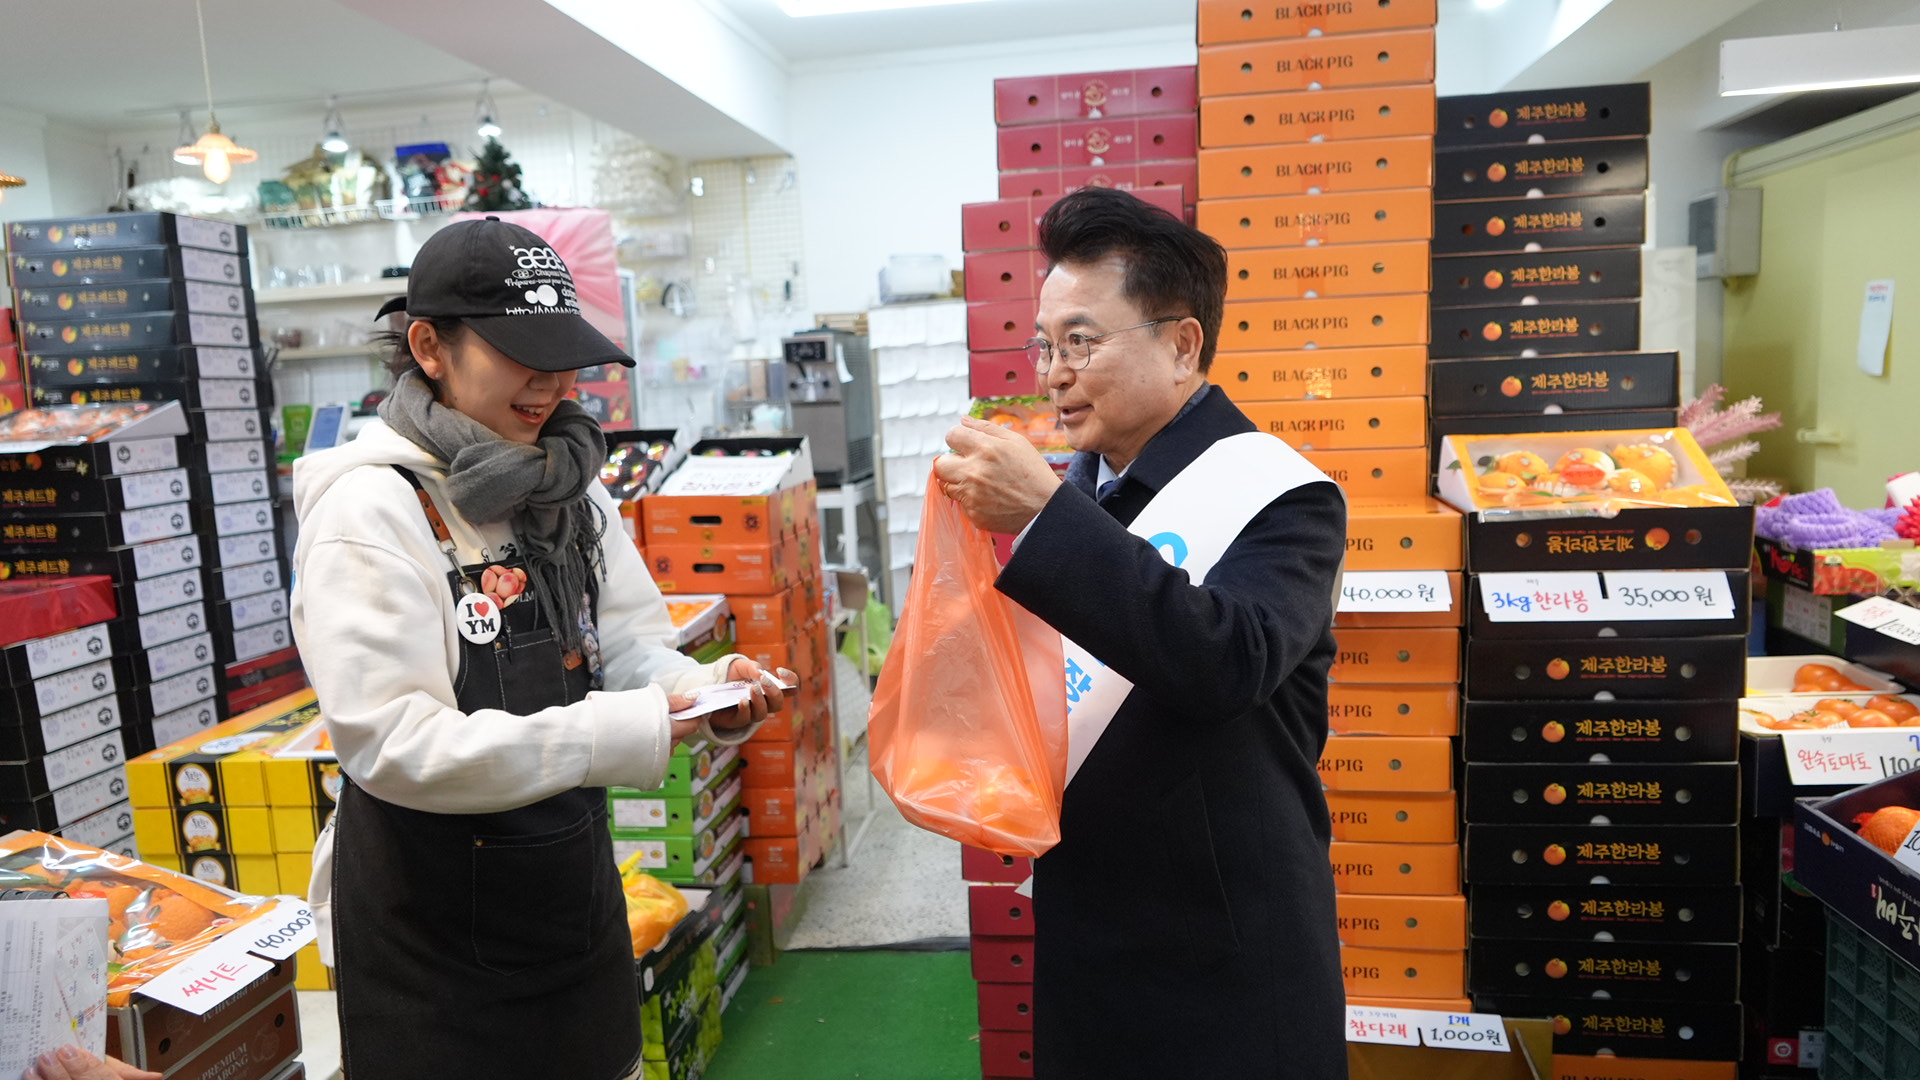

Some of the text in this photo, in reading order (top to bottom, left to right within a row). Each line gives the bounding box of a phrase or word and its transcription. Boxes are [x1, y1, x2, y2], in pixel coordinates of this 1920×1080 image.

[1275, 1, 1353, 20] BLACK PIG
[1276, 55, 1354, 73] BLACK PIG
[1279, 108, 1355, 126] BLACK PIG
[1516, 101, 1588, 120] 제주한라봉
[1276, 161, 1352, 177] BLACK PIG
[1514, 156, 1585, 175] 제주한라봉
[1274, 212, 1351, 228] BLACK PIG
[1513, 211, 1583, 229] 제주한라봉
[1273, 264, 1349, 280] BLACK PIG
[1511, 264, 1581, 282] 제주한라봉
[1273, 317, 1348, 331] BLACK PIG
[1509, 317, 1579, 335] 제주한라봉
[87, 355, 139, 370] 제주레드향
[1531, 371, 1610, 390] 제주한라봉
[90, 387, 142, 402] 제주레드향
[1270, 419, 1345, 433] BLACK PIG
[3, 523, 58, 539] 제주레드향
[1345, 538, 1374, 551] PIG
[14, 558, 71, 574] 제주레드향
[1417, 583, 1436, 603] 원
[1618, 585, 1716, 608] 35,000 원
[466, 603, 474, 618] I
[1492, 590, 1589, 614] 3kg 한라봉
[465, 618, 496, 635] YM
[1341, 652, 1369, 665] PIG
[1580, 656, 1667, 674] 제주한라봉
[1345, 705, 1372, 717] PIG
[1575, 719, 1662, 736] 제주한라봉
[1335, 759, 1363, 771] PIG
[1798, 749, 1872, 773] 완숙토마토
[1576, 782, 1662, 799] 제주한라봉
[1340, 812, 1368, 824] PIG
[1576, 843, 1661, 860] 제주한라봉
[1346, 864, 1373, 876] PIG
[1580, 899, 1664, 917] 제주한라봉
[1352, 918, 1380, 930] PIG
[1352, 967, 1380, 979] PIG
[1578, 958, 1662, 976] 제주한라봉
[1349, 1019, 1408, 1039] 참다래
[1447, 1015, 1471, 1026] 1개
[1582, 1015, 1666, 1034] 제주한라봉
